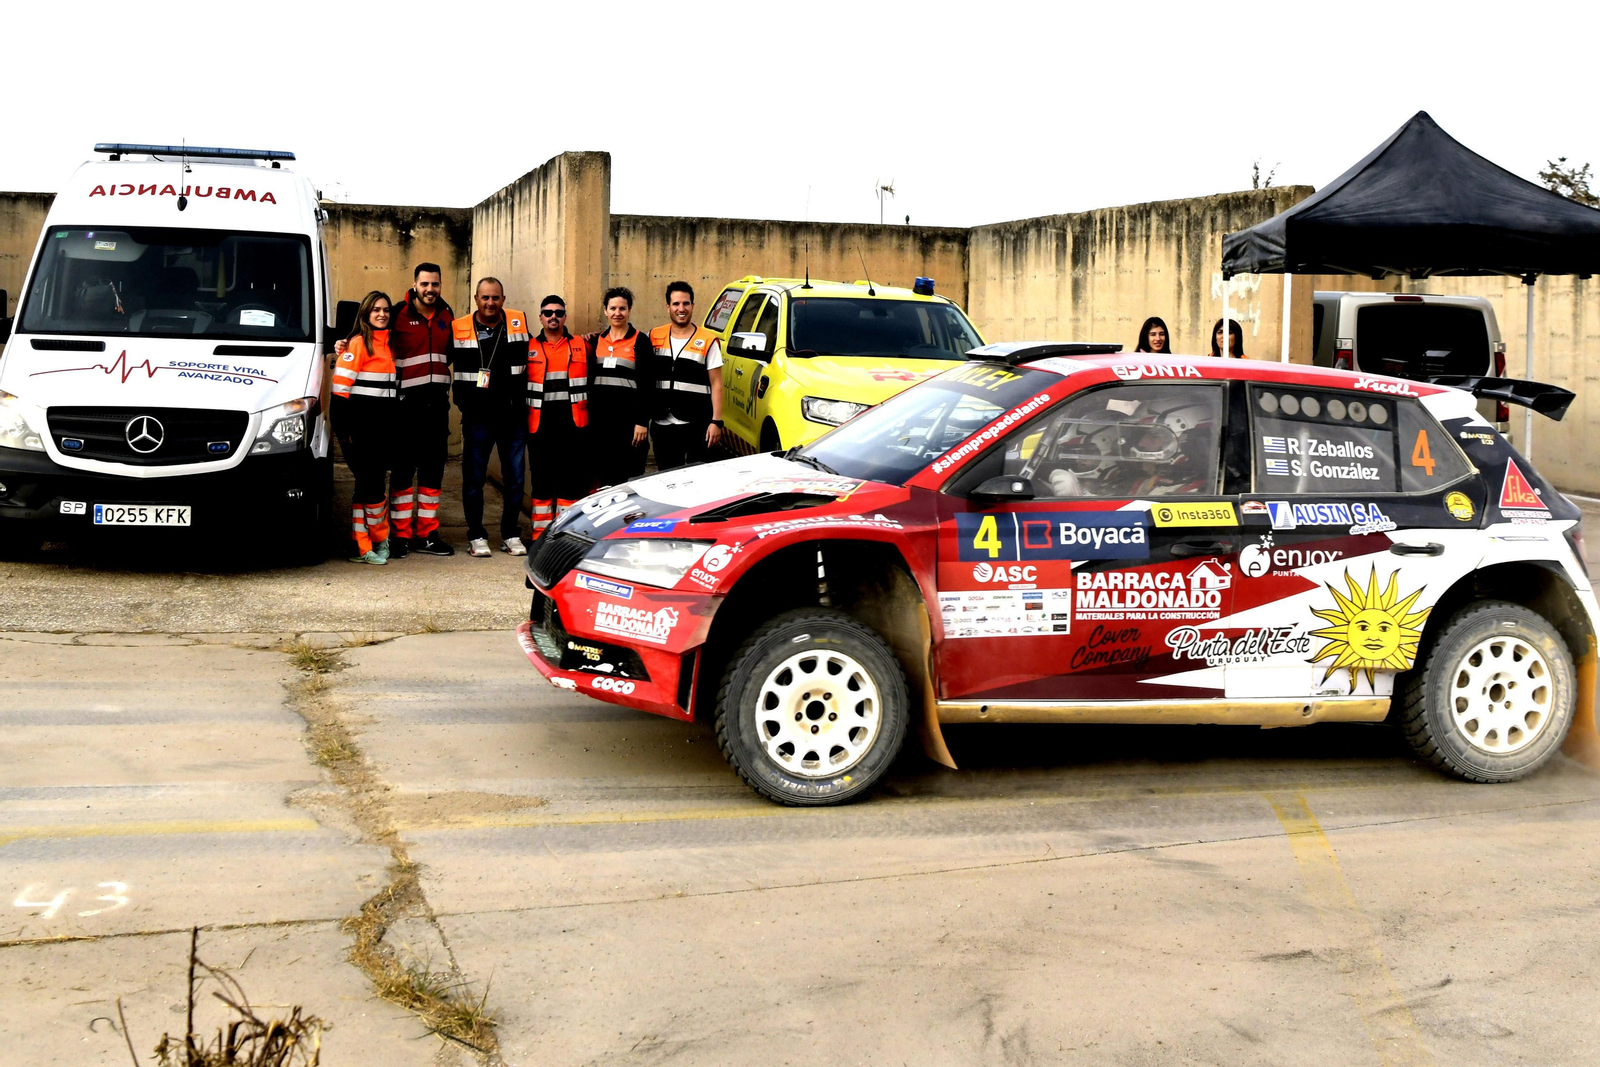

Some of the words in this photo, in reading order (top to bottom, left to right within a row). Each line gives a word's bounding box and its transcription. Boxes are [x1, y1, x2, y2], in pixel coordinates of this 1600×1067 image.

[169, 361, 229, 371] SOPORTE
[233, 366, 267, 377] VITAL
[177, 371, 254, 386] AVANZADO
[1286, 438, 1304, 456] R.
[1307, 438, 1374, 459] Zeballos
[1411, 429, 1436, 476] 4
[1291, 460, 1307, 478] S.
[1310, 461, 1380, 481] González
[1504, 475, 1537, 503] Sika
[62, 502, 84, 513] SP
[105, 507, 148, 523] 0255
[155, 508, 188, 524] KFK
[1177, 508, 1232, 521] Insta360
[1295, 503, 1351, 524] AUSIN
[1353, 504, 1388, 523] S.A.
[973, 515, 1002, 558] 4
[992, 565, 1038, 583] ASC
[1077, 572, 1186, 589] BARRACA
[1075, 590, 1221, 608] MALDONADO
[597, 602, 653, 623] BARRACA
[1075, 612, 1124, 620] MATERIALES
[1126, 612, 1146, 620] PARA
[1148, 612, 1158, 620] LA
[1159, 611, 1220, 620] CONSTRUCCIÓN
[594, 612, 671, 638] MALDONADO
[1088, 625, 1142, 649] Cover
[1167, 627, 1229, 658] Punta
[1234, 629, 1266, 656] del
[1270, 626, 1311, 655] Este
[1070, 645, 1153, 669] Company
[1208, 655, 1266, 664] URUGUAY
